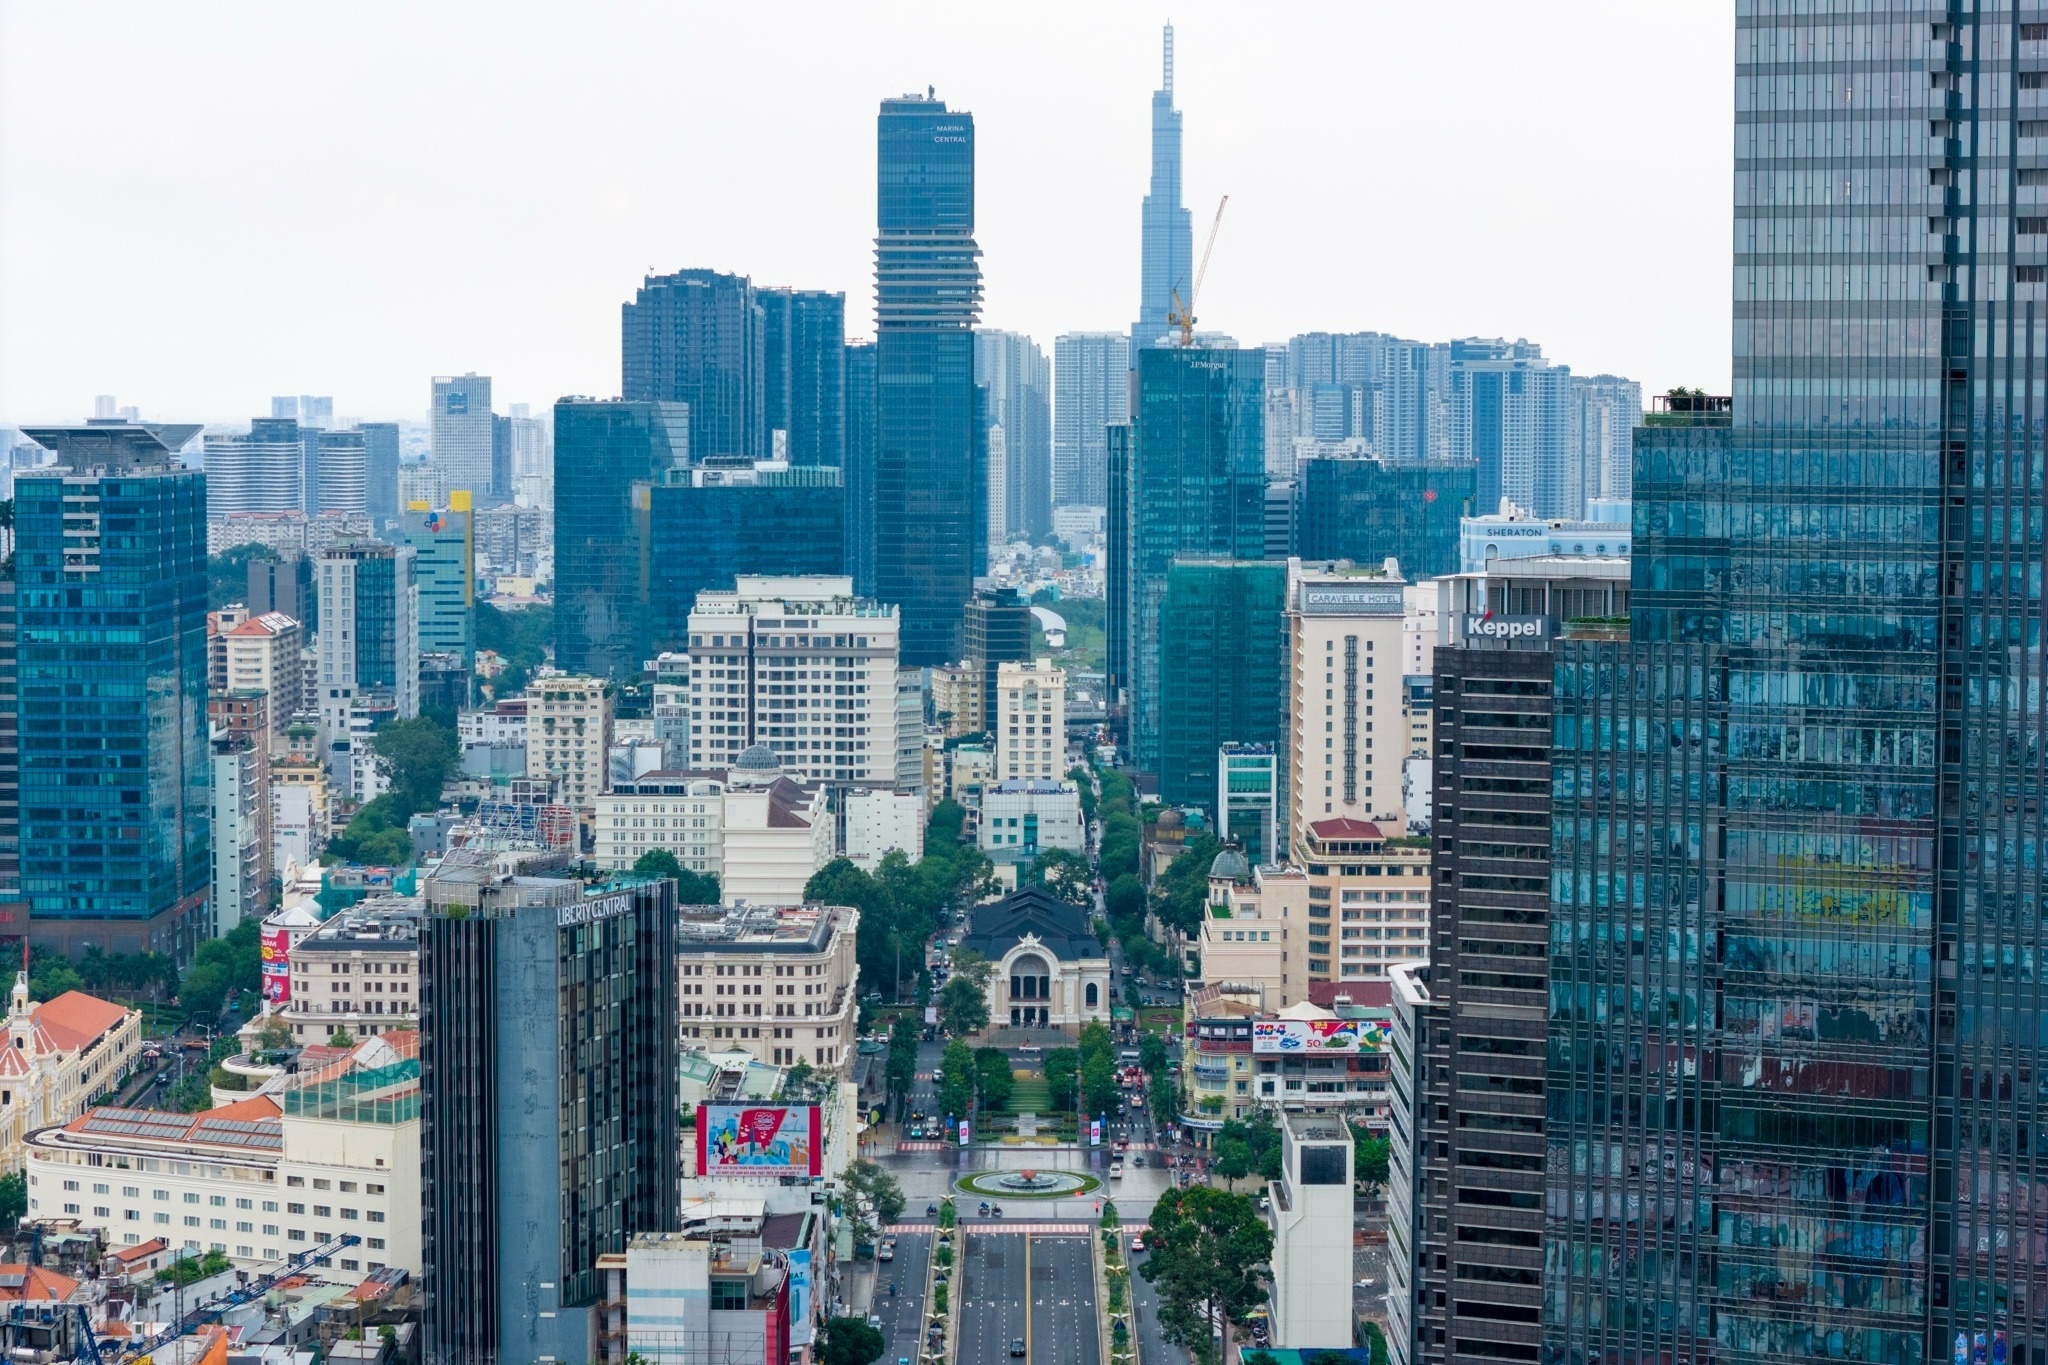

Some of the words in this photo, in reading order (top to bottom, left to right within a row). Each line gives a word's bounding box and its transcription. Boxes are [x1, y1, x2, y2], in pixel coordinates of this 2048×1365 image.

[1486, 528, 1542, 537] SHERATON
[1311, 595, 1364, 603] CARAVELLE
[1368, 595, 1399, 603] HOTEL
[1468, 616, 1542, 638] Keppel
[557, 902, 592, 926] LIBERTY
[591, 893, 631, 918] CENTRAL
